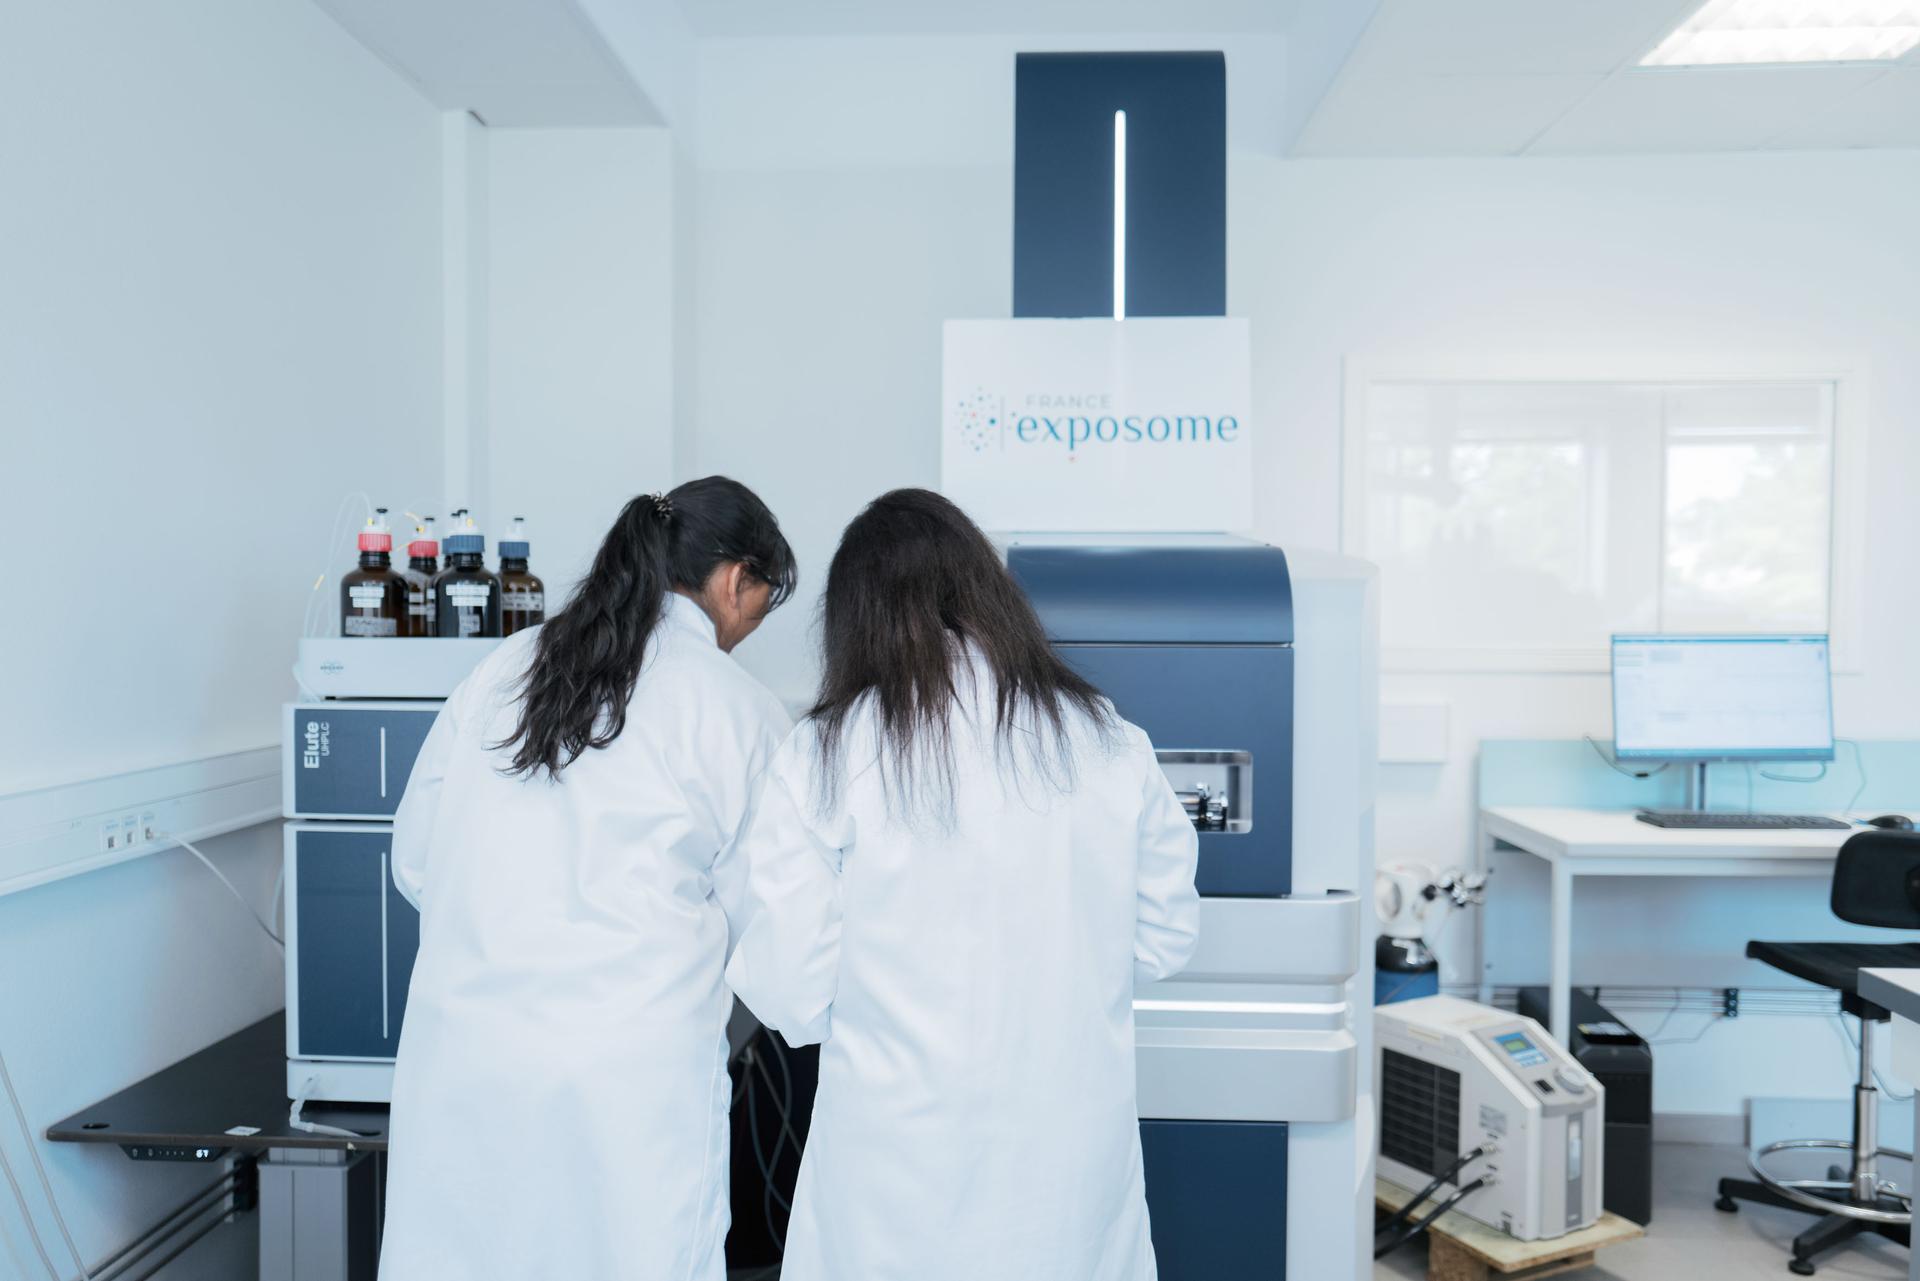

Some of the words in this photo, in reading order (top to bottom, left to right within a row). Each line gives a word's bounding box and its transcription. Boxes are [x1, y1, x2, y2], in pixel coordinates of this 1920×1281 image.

[1026, 394, 1111, 409] FRANCE
[1016, 414, 1239, 451] exposome
[303, 720, 320, 769] Elute
[320, 721, 331, 757] UHPLC
